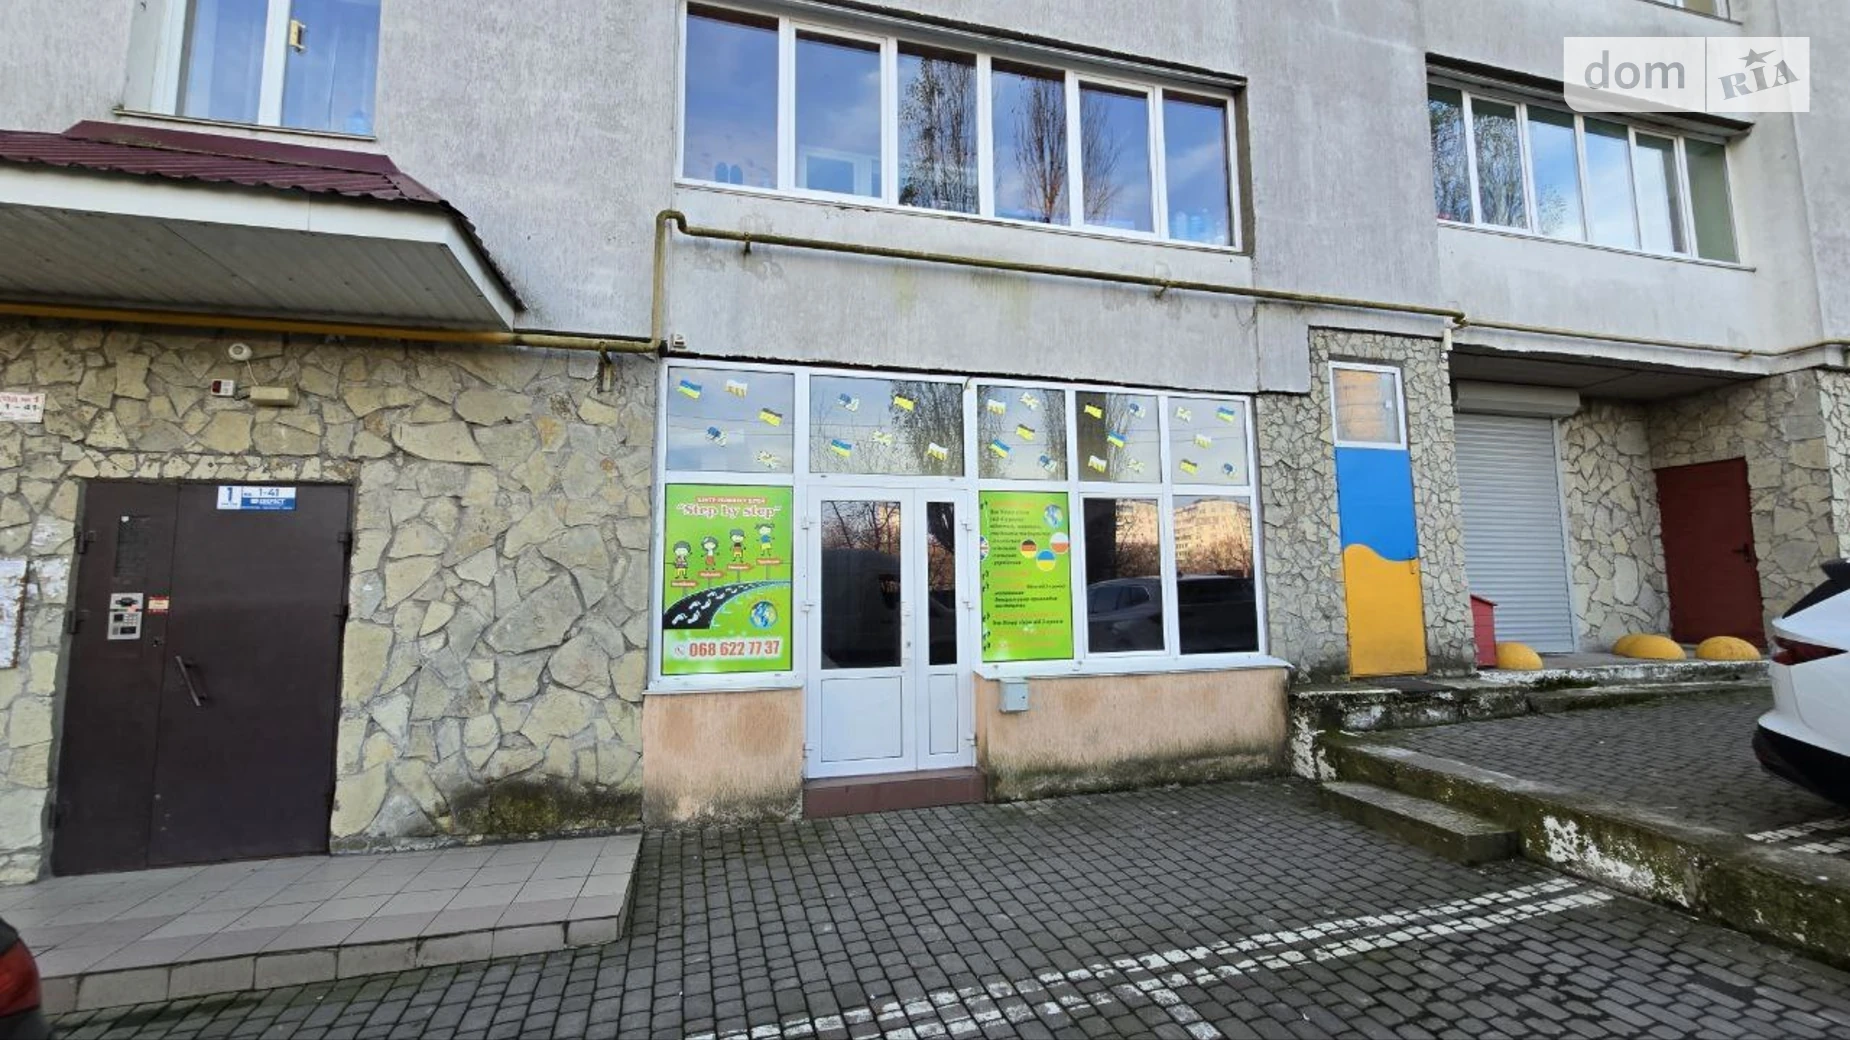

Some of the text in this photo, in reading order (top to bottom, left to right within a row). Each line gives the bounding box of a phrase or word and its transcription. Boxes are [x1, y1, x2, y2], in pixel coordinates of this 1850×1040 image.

[227, 487, 233, 501] 1
[720, 504, 740, 519] by
[689, 640, 780, 657] 068 622 77 37
